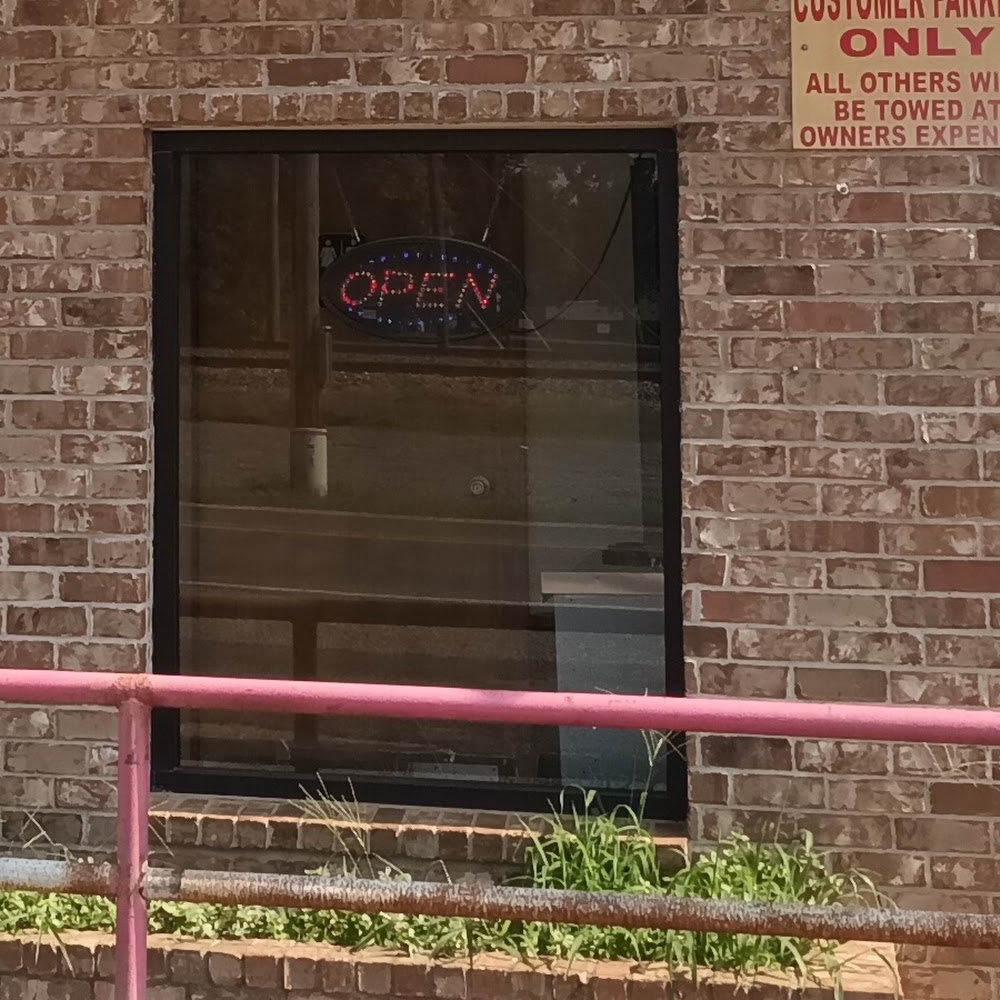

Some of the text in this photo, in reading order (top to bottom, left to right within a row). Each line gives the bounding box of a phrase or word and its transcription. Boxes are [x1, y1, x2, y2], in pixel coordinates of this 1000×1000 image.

[839, 27, 994, 57] ONLY
[806, 72, 852, 94] ALL
[860, 71, 961, 93] OTHERS
[834, 99, 1000, 121] BE TOWED AT
[800, 124, 999, 147] OWNERS EXPEN
[341, 269, 499, 309] OPEN
